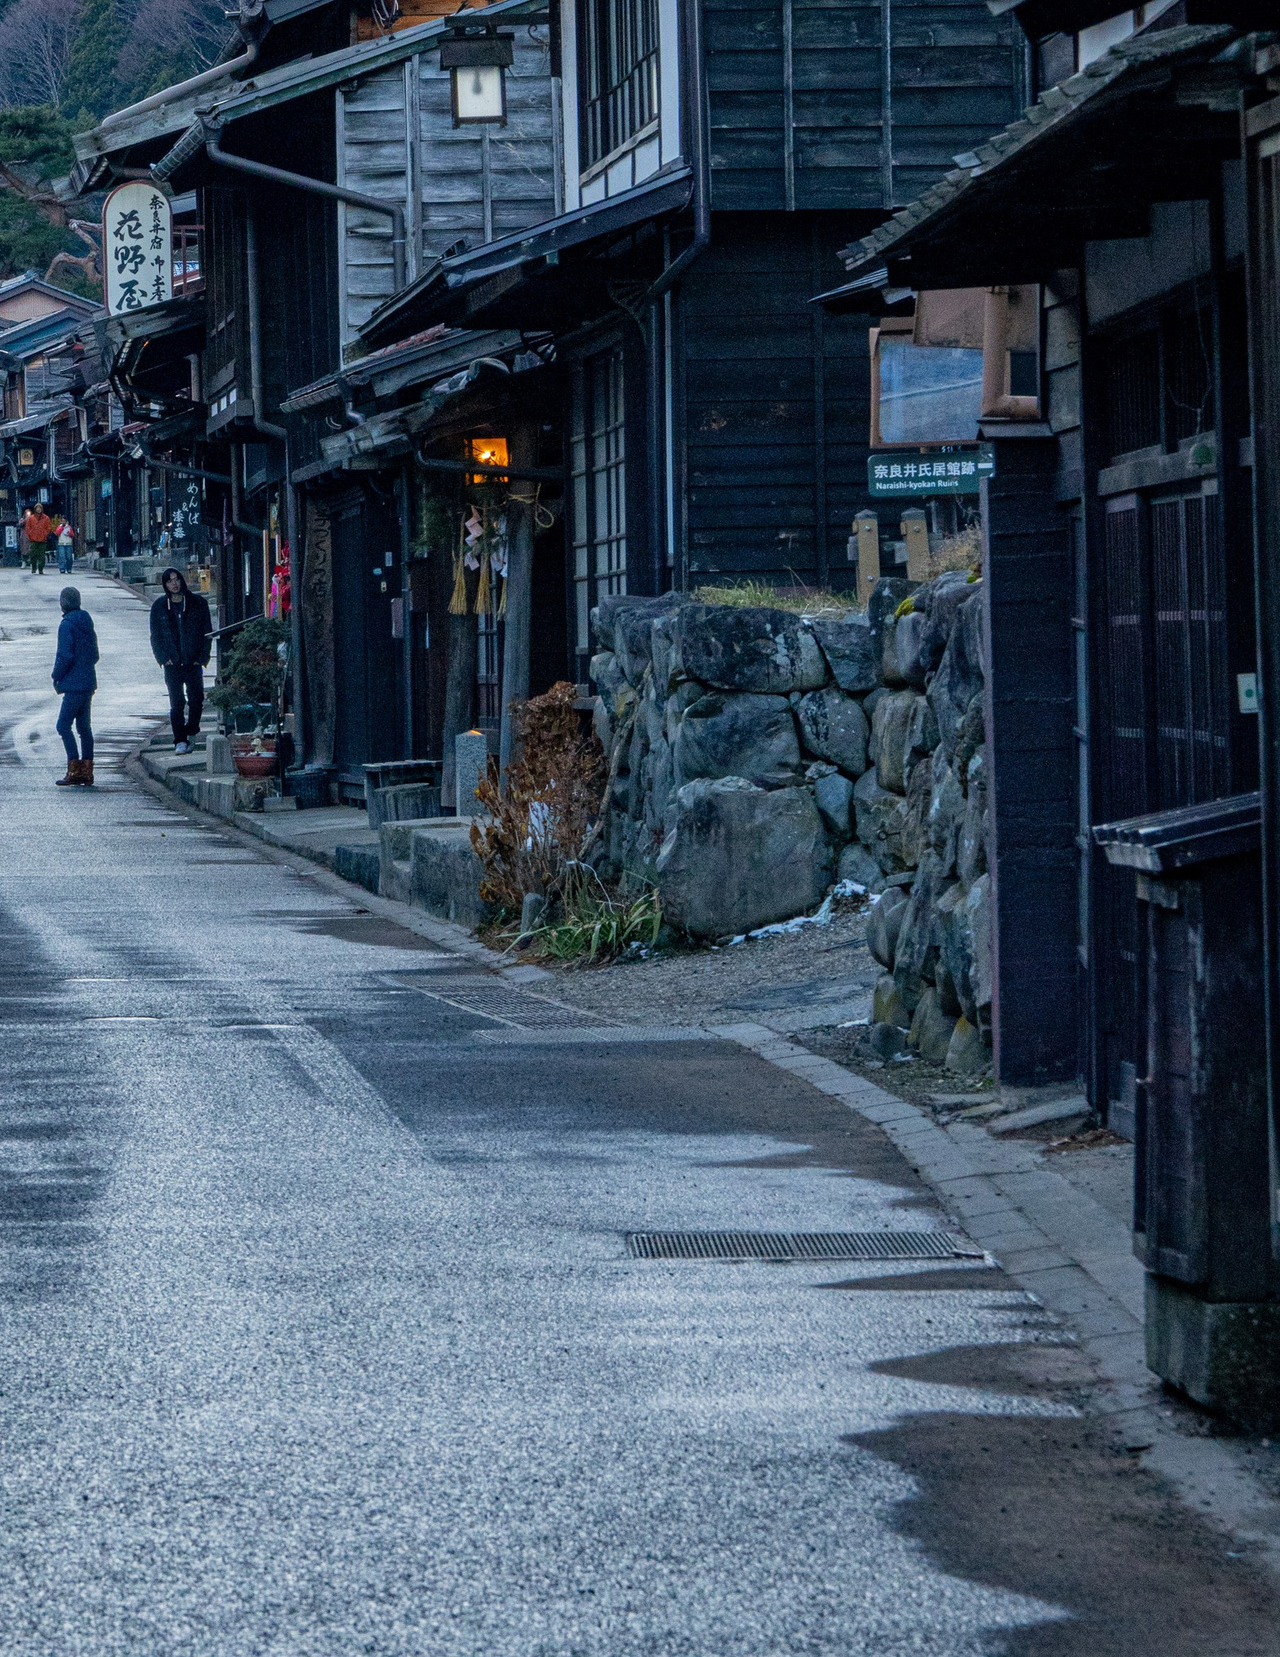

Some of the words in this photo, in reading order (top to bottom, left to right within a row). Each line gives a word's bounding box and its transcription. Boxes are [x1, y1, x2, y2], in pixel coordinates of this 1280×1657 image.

[149, 194, 165, 251] 奈良井宿
[113, 209, 148, 311] 花野屋
[874, 461, 976, 479] 奈良井氏居館跡
[875, 481, 936, 491] Naraishi-kyokan
[937, 479, 959, 488] Ruins
